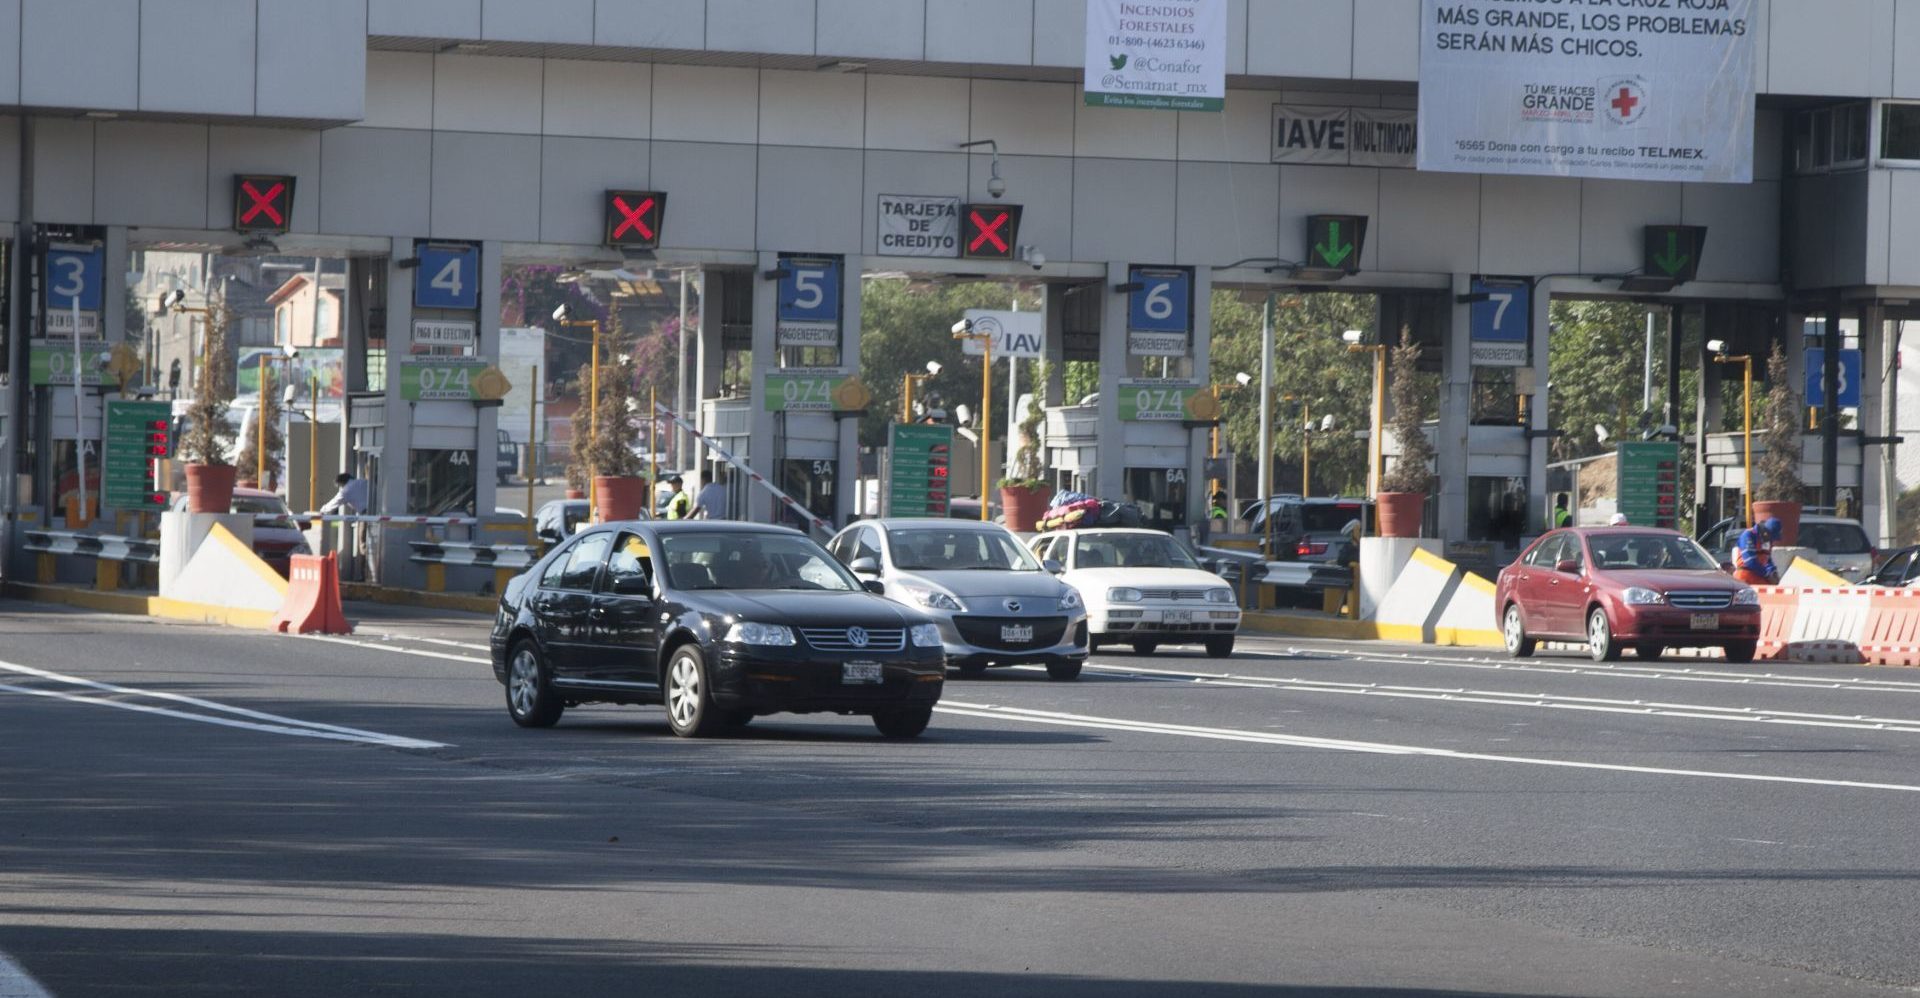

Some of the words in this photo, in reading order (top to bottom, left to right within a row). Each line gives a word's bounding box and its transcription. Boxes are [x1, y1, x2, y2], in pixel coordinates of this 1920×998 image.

[1120, 3, 1195, 18] INCENDIOS
[1120, 19, 1195, 33] FORESTALES
[1437, 5, 1480, 26] MÁS
[1485, 9, 1575, 32] GRANDE,
[1582, 13, 1621, 32] LOS
[1626, 15, 1746, 36] PROBLEMAS
[1437, 31, 1505, 52] SERÁN
[1511, 33, 1553, 54] MÁS
[1561, 38, 1642, 58] CHICOS.
[1134, 57, 1202, 74] @Conafor
[1101, 74, 1208, 94] @Semarnat_mx
[1523, 83, 1538, 94] TÚ
[1542, 85, 1557, 95] ME
[1559, 86, 1595, 97] HACES
[1523, 94, 1595, 111] GRANDE
[1278, 118, 1345, 150] IAVE
[1488, 141, 1517, 152] Dona
[1520, 144, 1541, 153] con
[1544, 145, 1574, 156] cargo
[1577, 146, 1584, 154] a
[1587, 146, 1598, 155] tu
[1601, 146, 1635, 157] recibo
[882, 202, 957, 217] TARJETA
[909, 219, 929, 232] DE
[883, 234, 954, 249] CREDITO
[54, 256, 85, 296] 3
[430, 258, 462, 297] 4
[794, 270, 824, 309] 5
[1144, 282, 1173, 320] 6
[1489, 293, 1512, 330] 7
[66, 314, 95, 328] EFTIVO
[416, 326, 431, 339] PAGO
[433, 327, 441, 339] EN
[443, 327, 471, 340] EFECTIVO
[420, 368, 469, 389] 074
[784, 380, 831, 401] 074
[1136, 390, 1183, 411] 074
[450, 451, 470, 466] 4A
[813, 461, 832, 475] 5A
[1166, 468, 1185, 483] 6A
[1506, 476, 1526, 491] 7A
